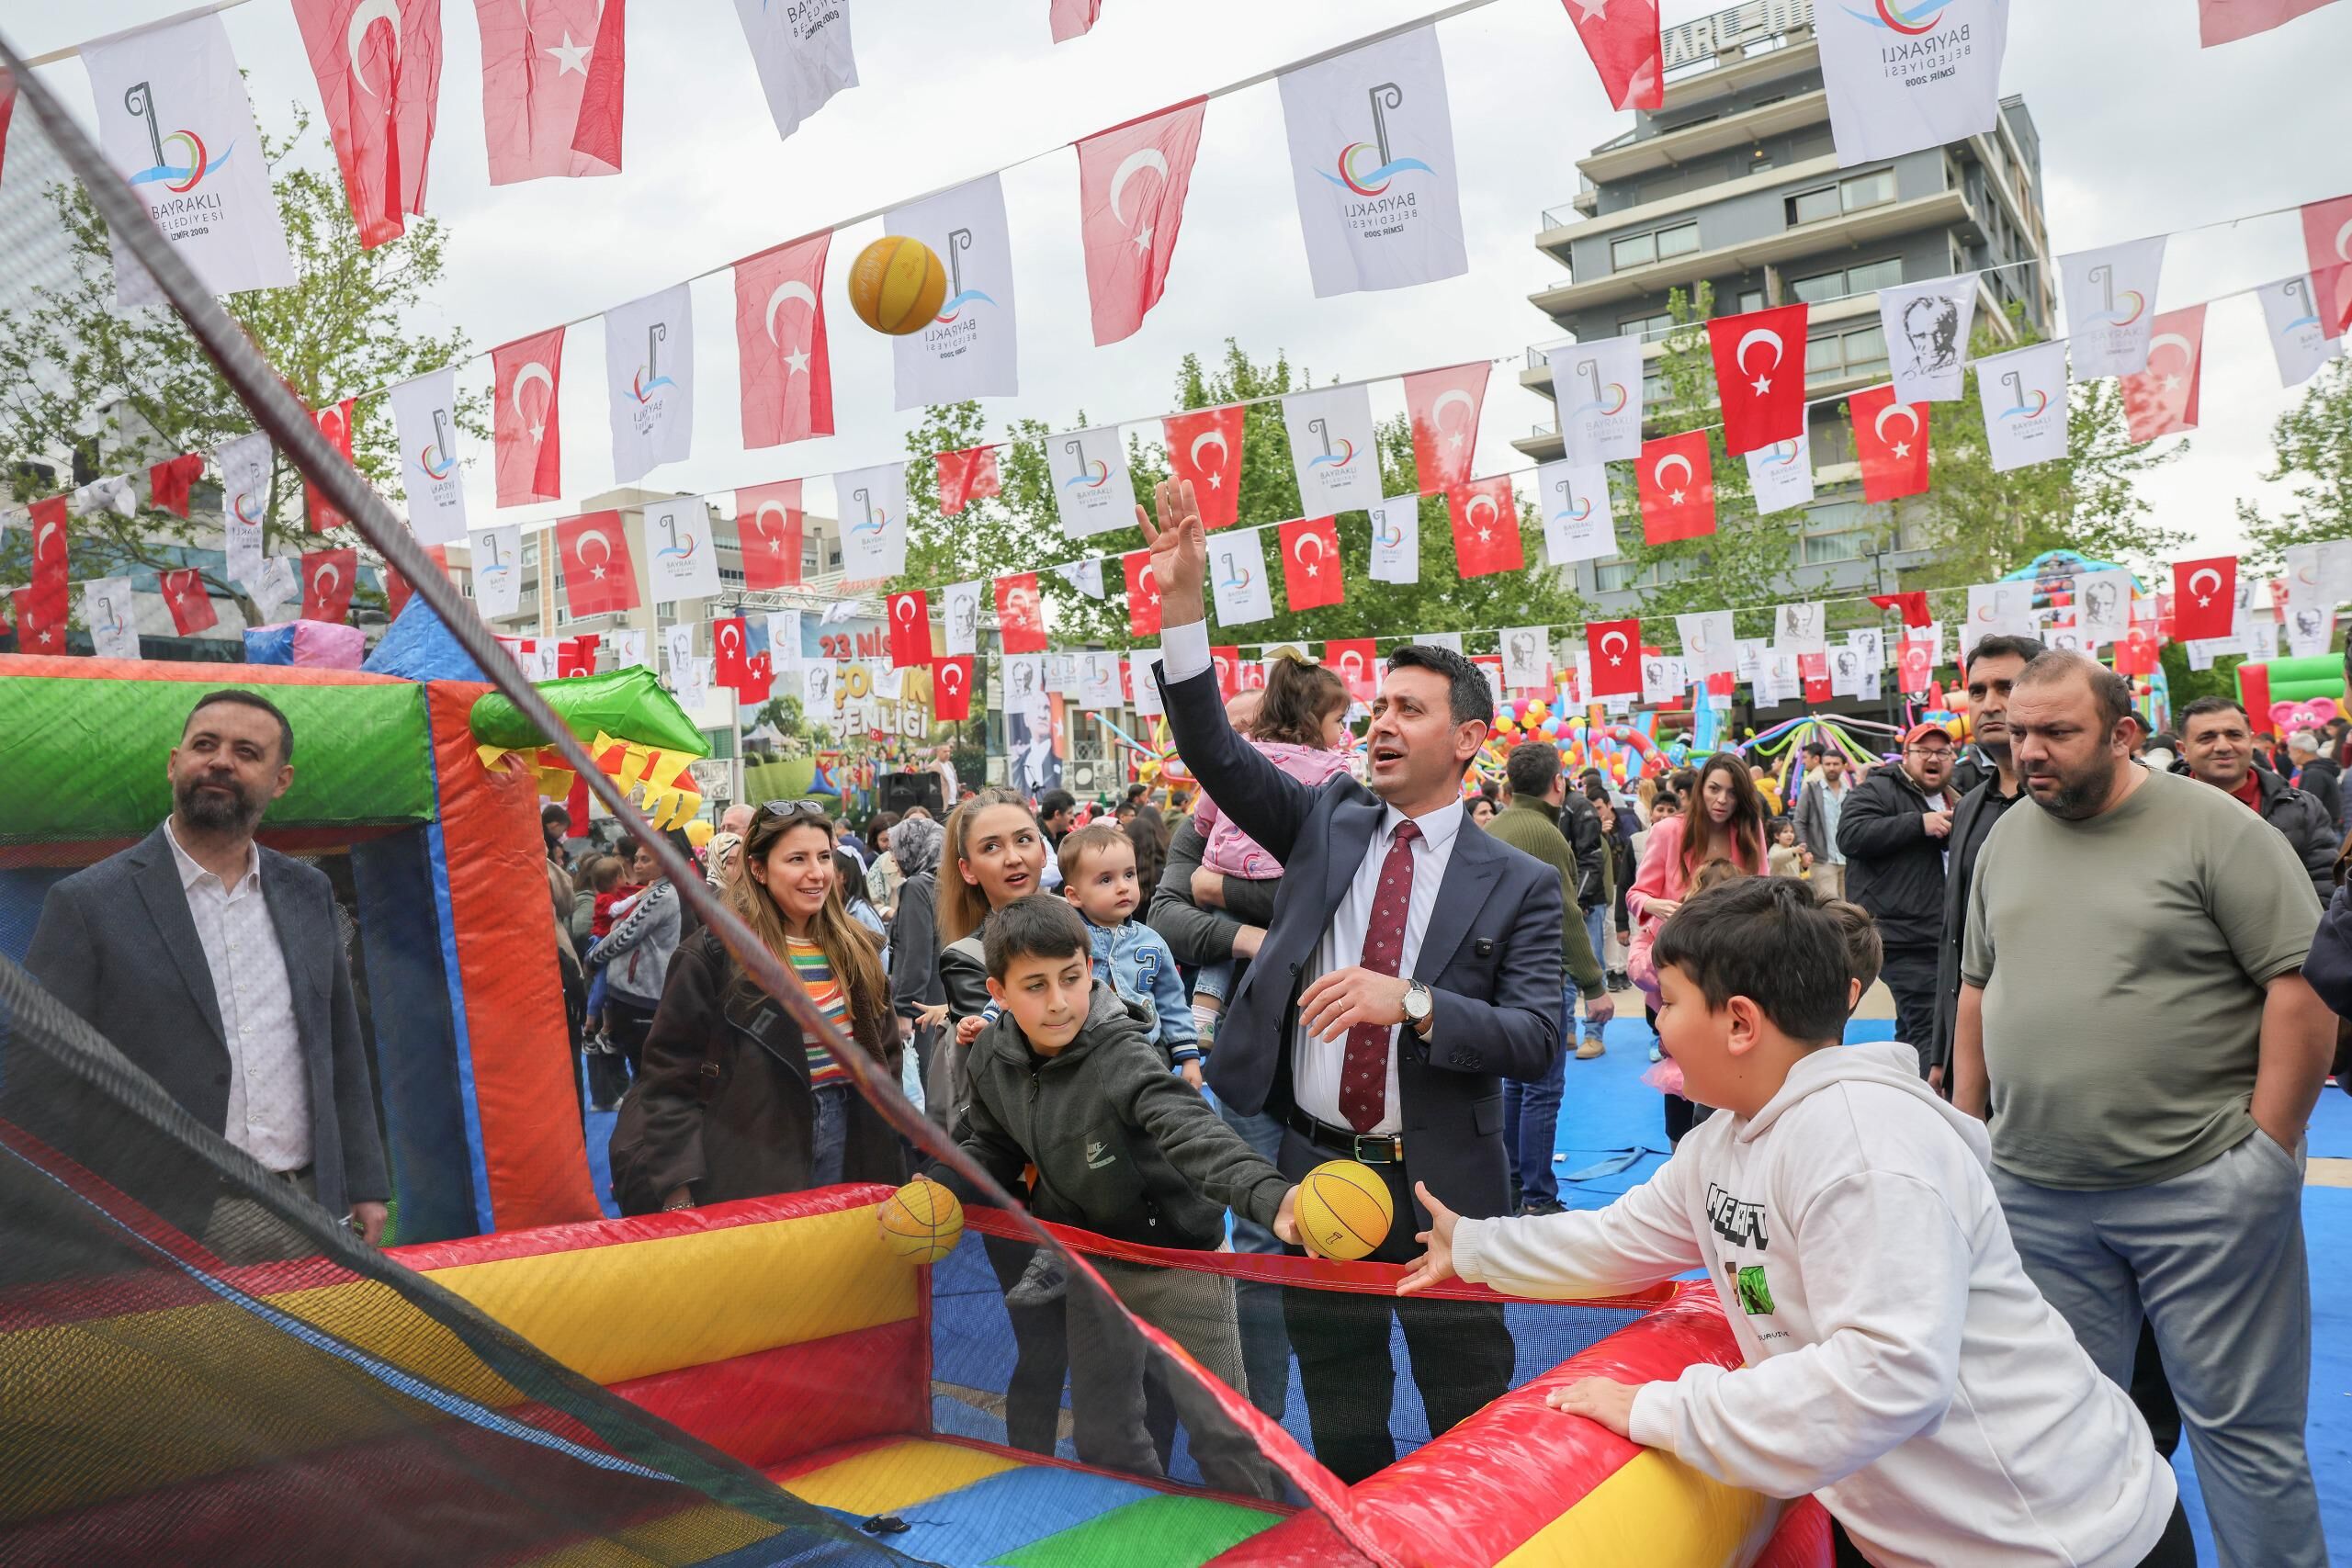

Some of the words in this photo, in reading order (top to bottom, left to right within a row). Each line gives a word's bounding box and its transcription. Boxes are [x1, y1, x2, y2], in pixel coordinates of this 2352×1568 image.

[152, 193, 221, 220] BAYRAKLI
[162, 209, 224, 231] ELEDİYESİ
[190, 227, 209, 238] 2009
[819, 633, 851, 662] 23
[834, 663, 927, 710] ÇOK
[1135, 946, 1162, 992] 2
[1087, 1141, 1102, 1154] NIKE
